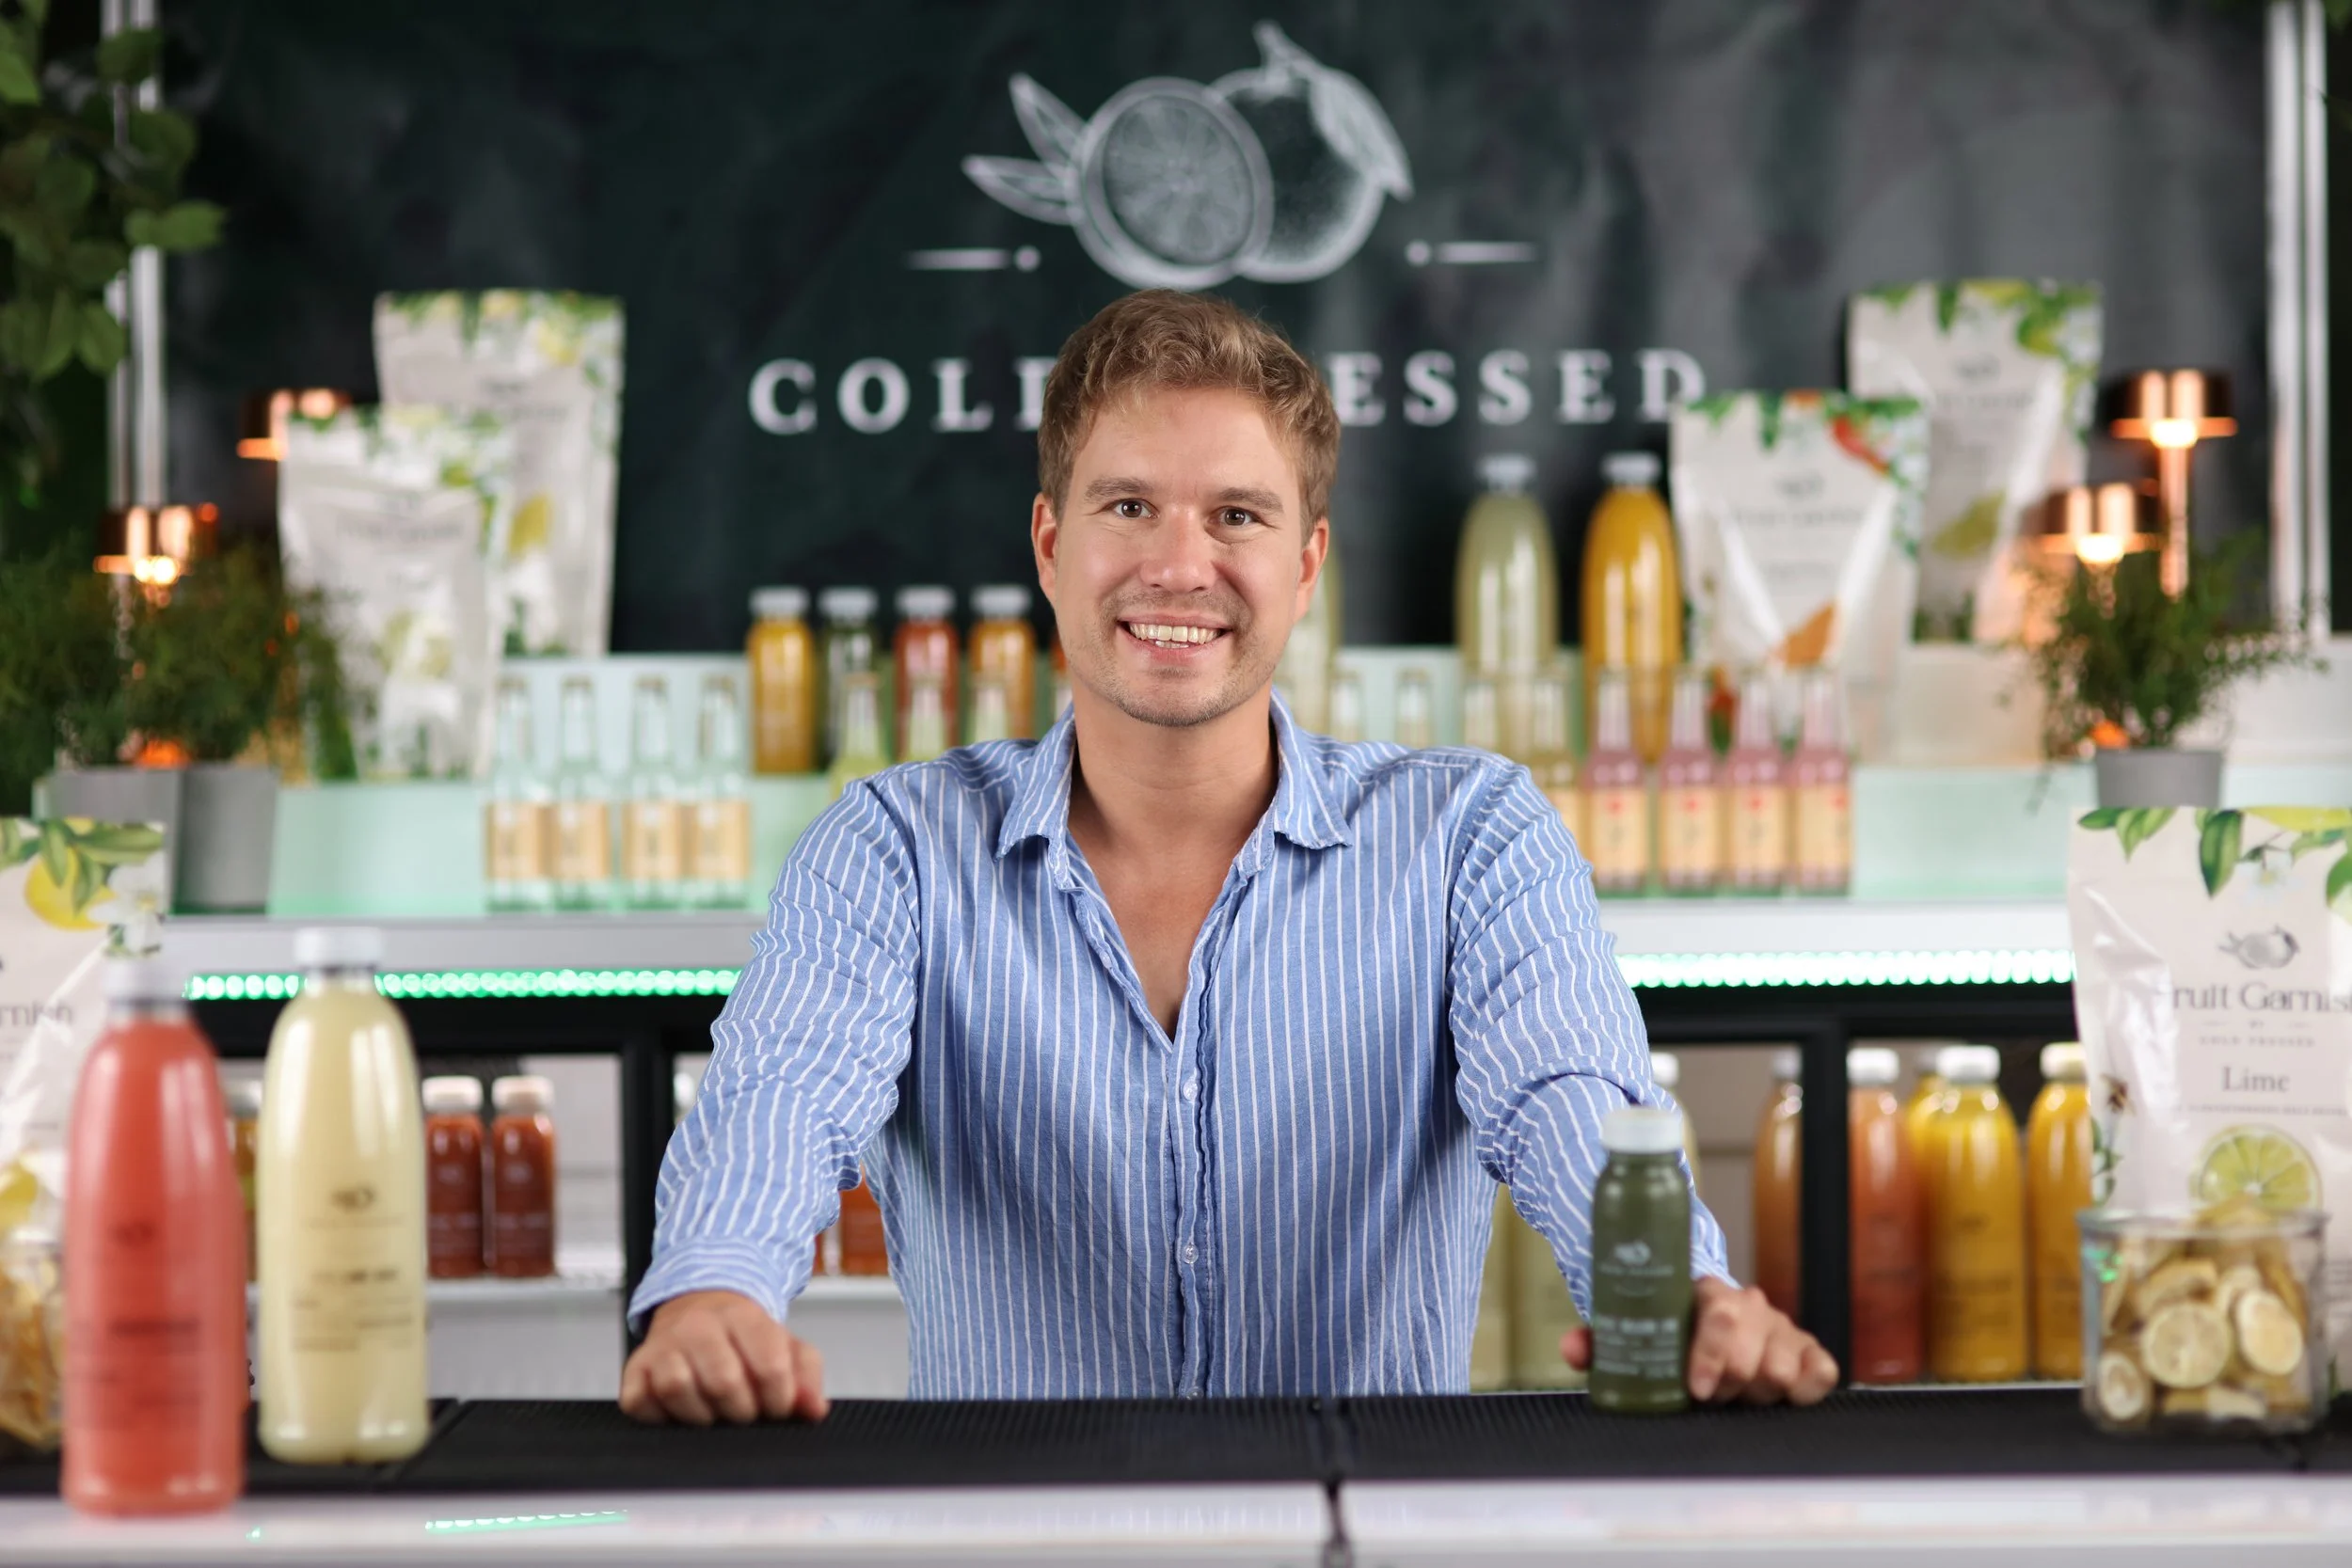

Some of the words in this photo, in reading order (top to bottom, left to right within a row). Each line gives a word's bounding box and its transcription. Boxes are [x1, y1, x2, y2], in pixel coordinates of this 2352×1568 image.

[1324, 348, 1706, 427] ESSED
[2172, 983, 2231, 1011] ruit
[2238, 981, 2352, 1013] Garnis
[2221, 1065, 2290, 1092] Lime
